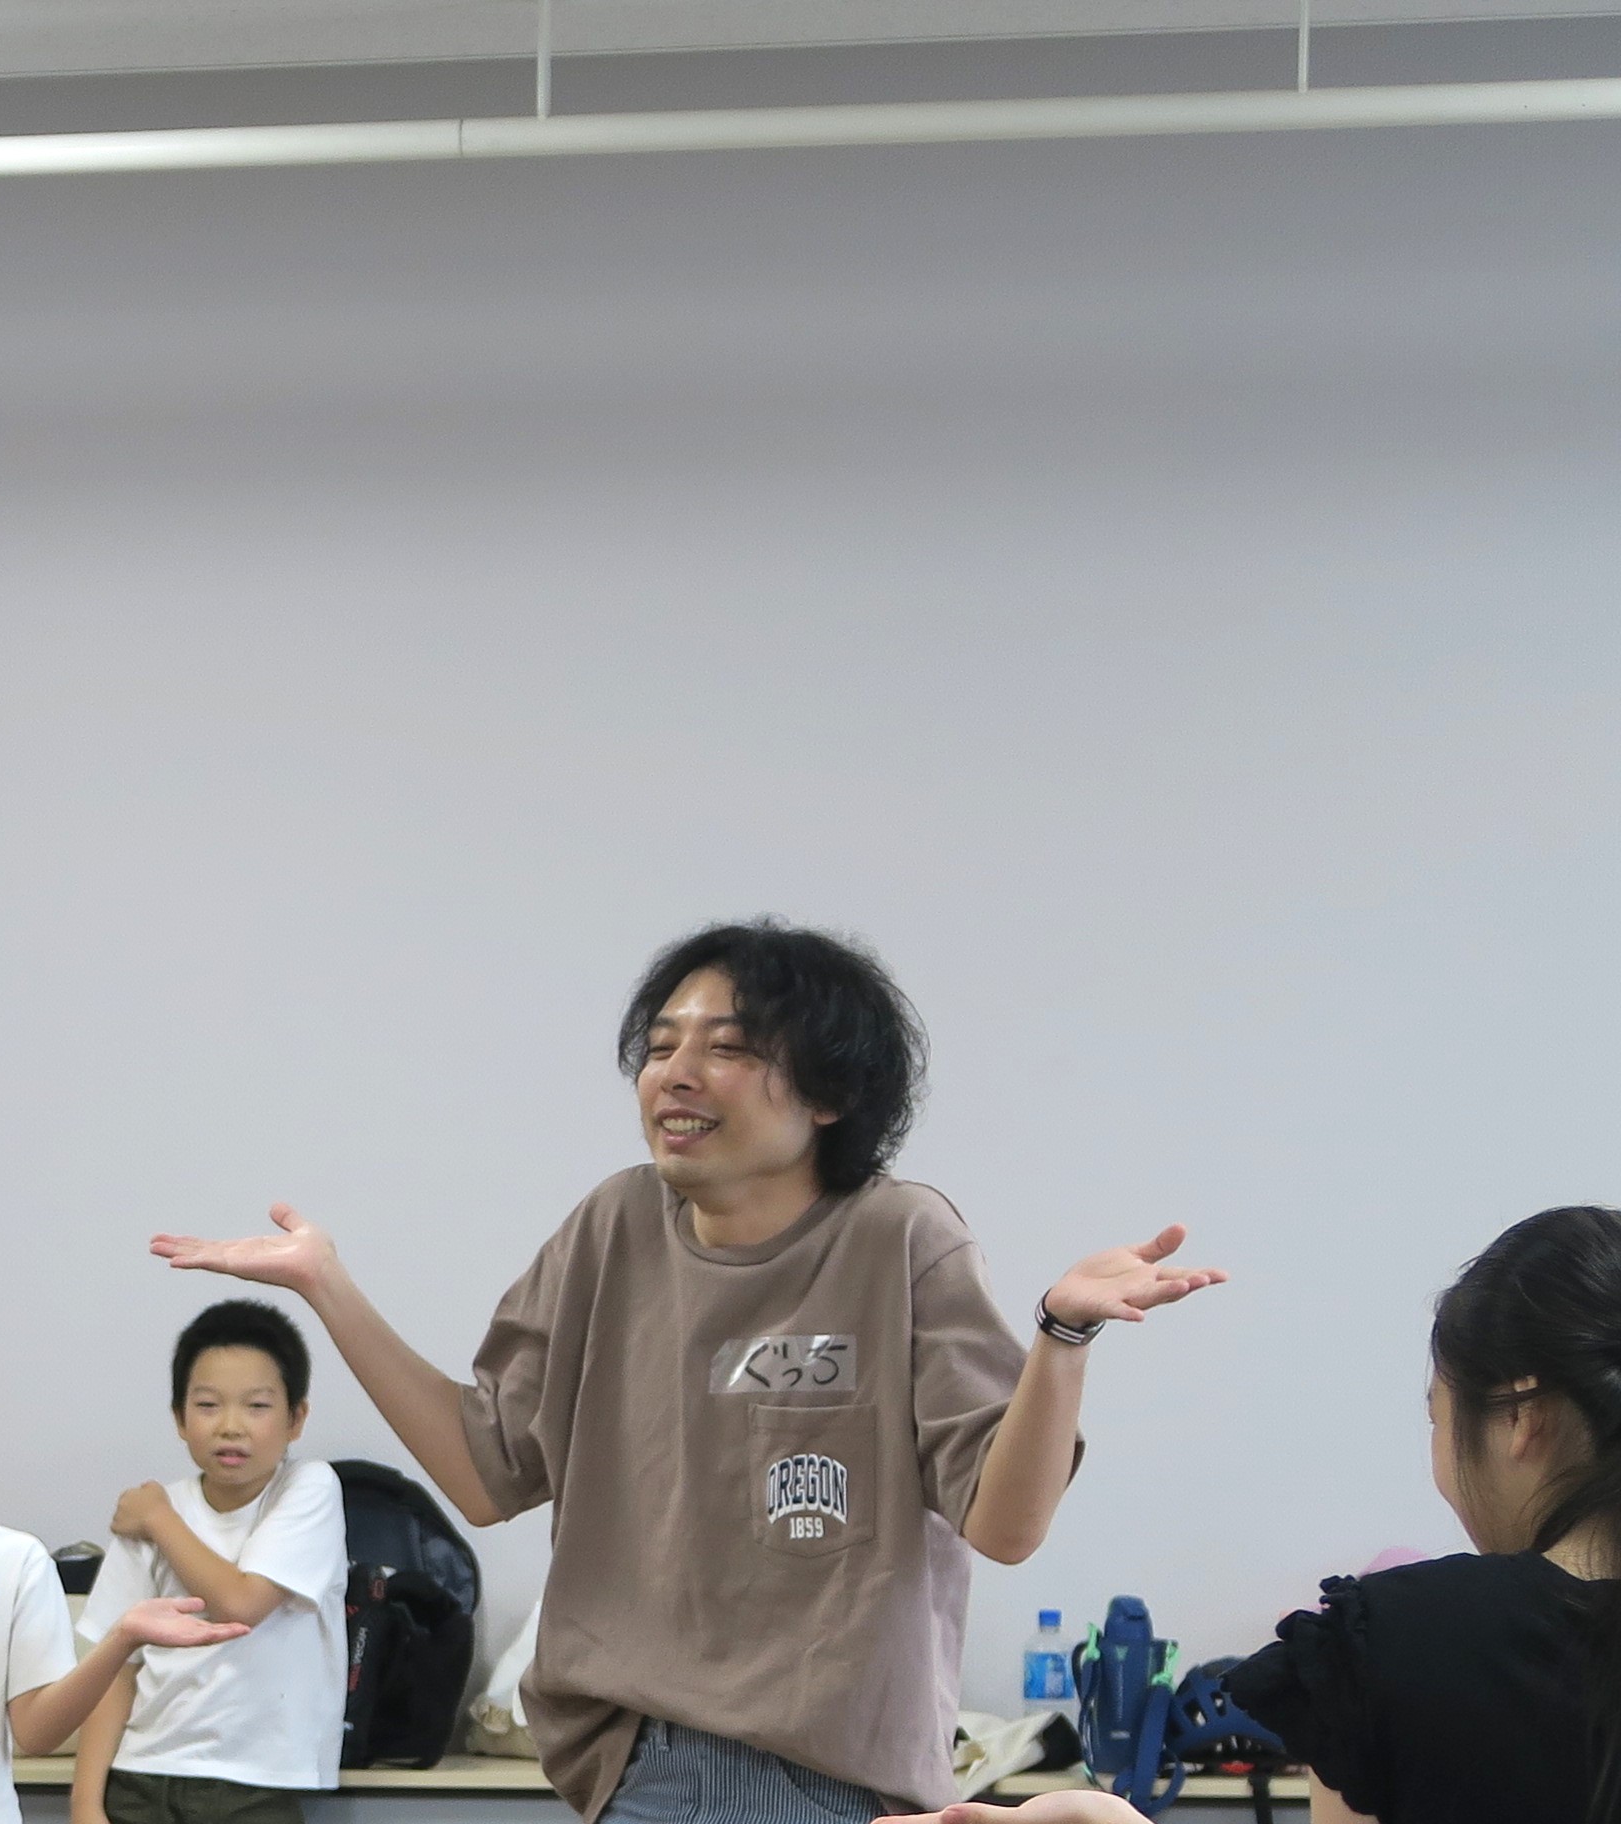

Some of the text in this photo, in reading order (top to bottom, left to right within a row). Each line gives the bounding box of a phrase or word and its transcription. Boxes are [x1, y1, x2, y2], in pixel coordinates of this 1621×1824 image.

[743, 1342, 848, 1388] ぐっち
[765, 1453, 849, 1525] OREGON
[789, 1516, 825, 1539] 1859
